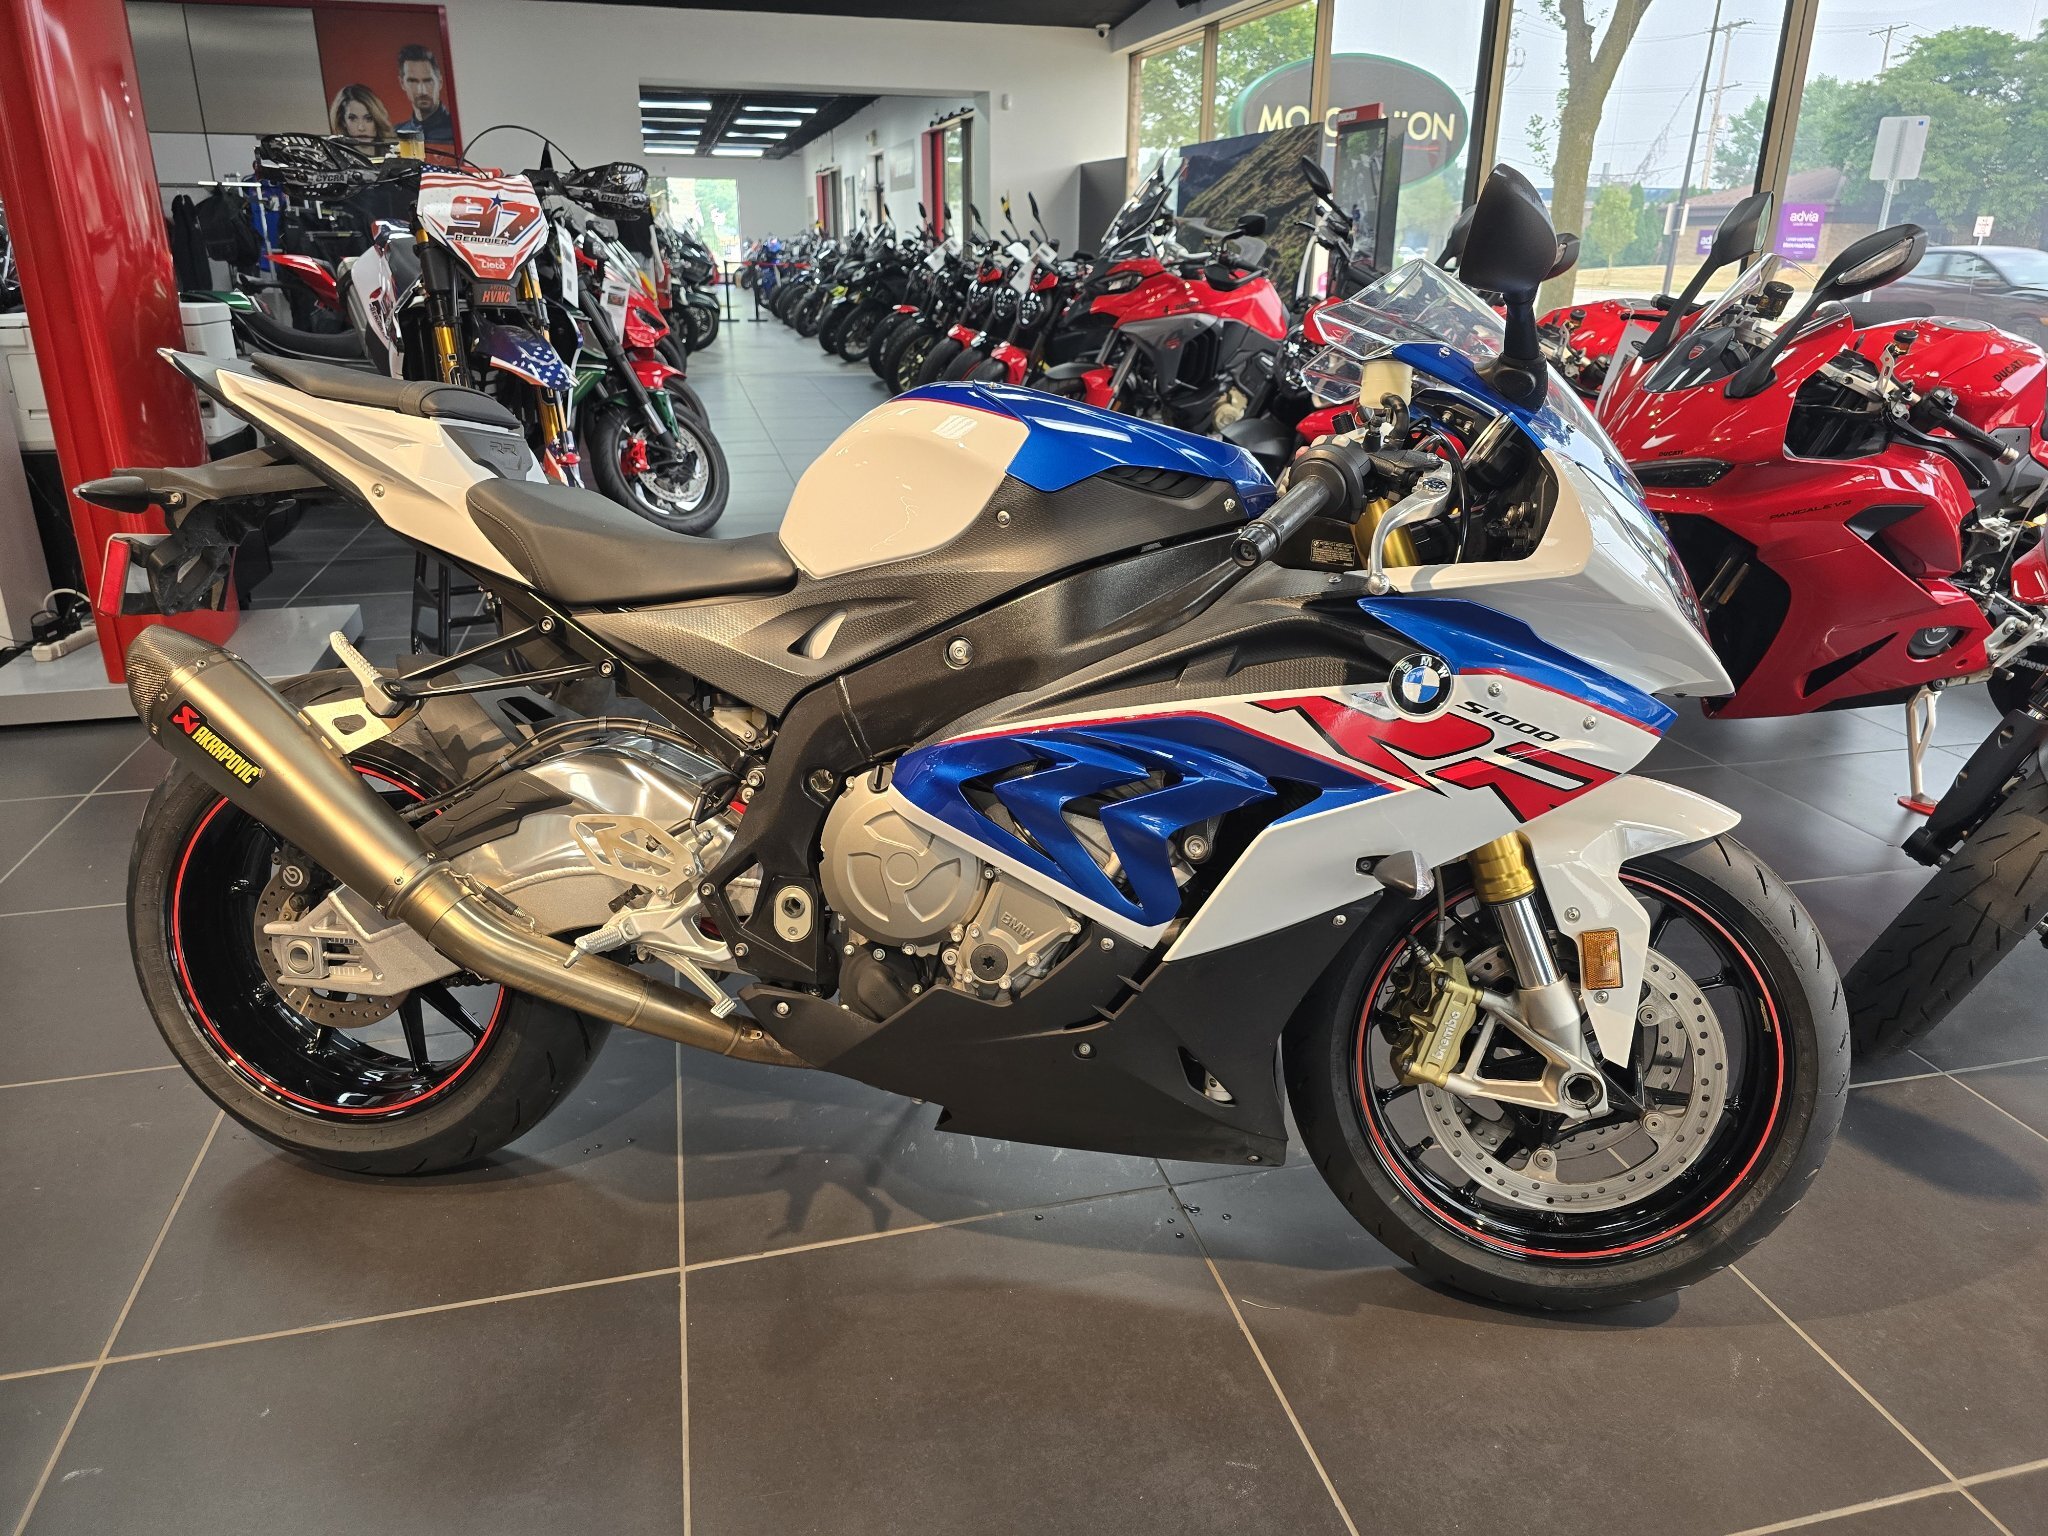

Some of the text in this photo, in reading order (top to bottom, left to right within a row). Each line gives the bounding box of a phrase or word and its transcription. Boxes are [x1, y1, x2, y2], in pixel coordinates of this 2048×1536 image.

[446, 195, 540, 241] 97
[1790, 211, 1819, 223] advia
[481, 290, 511, 303] HVMC
[1993, 359, 2024, 382] DUCATI
[1397, 655, 1450, 679] BMW
[1455, 700, 1560, 742] S1000
[1000, 911, 1035, 940] BMW
[1430, 1010, 1462, 1060] brembo
